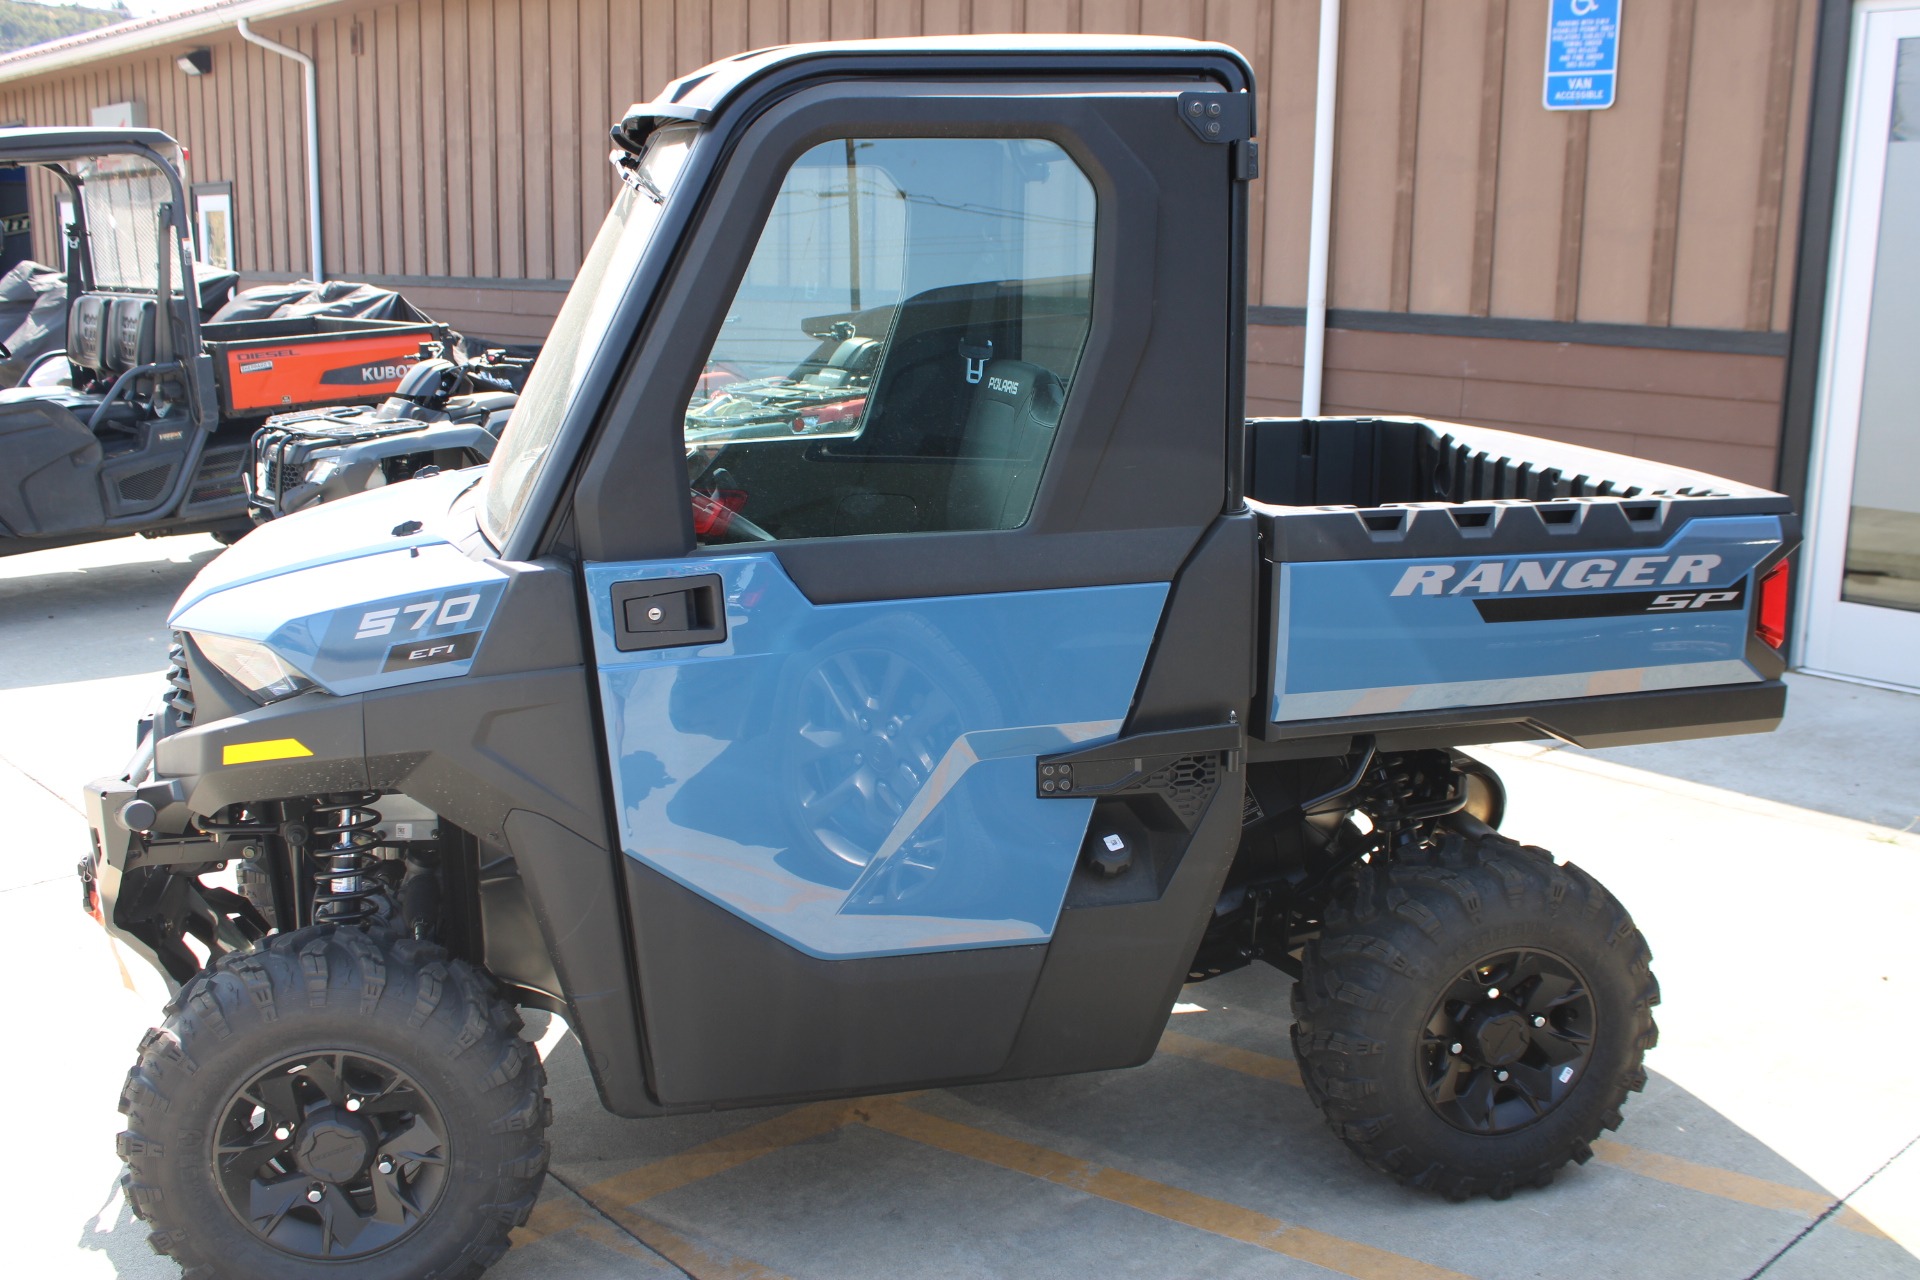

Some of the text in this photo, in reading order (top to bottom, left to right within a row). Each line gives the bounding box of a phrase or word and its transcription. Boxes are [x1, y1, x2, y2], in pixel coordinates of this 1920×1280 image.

[1567, 77, 1593, 89] VAN
[1554, 90, 1604, 100] ACCESSIBLE
[237, 350, 299, 360] DIESEL
[988, 376, 1019, 395] POLARIS
[1390, 554, 1721, 597] RANGER
[1646, 591, 1740, 611] SP
[408, 643, 456, 660] EFI
